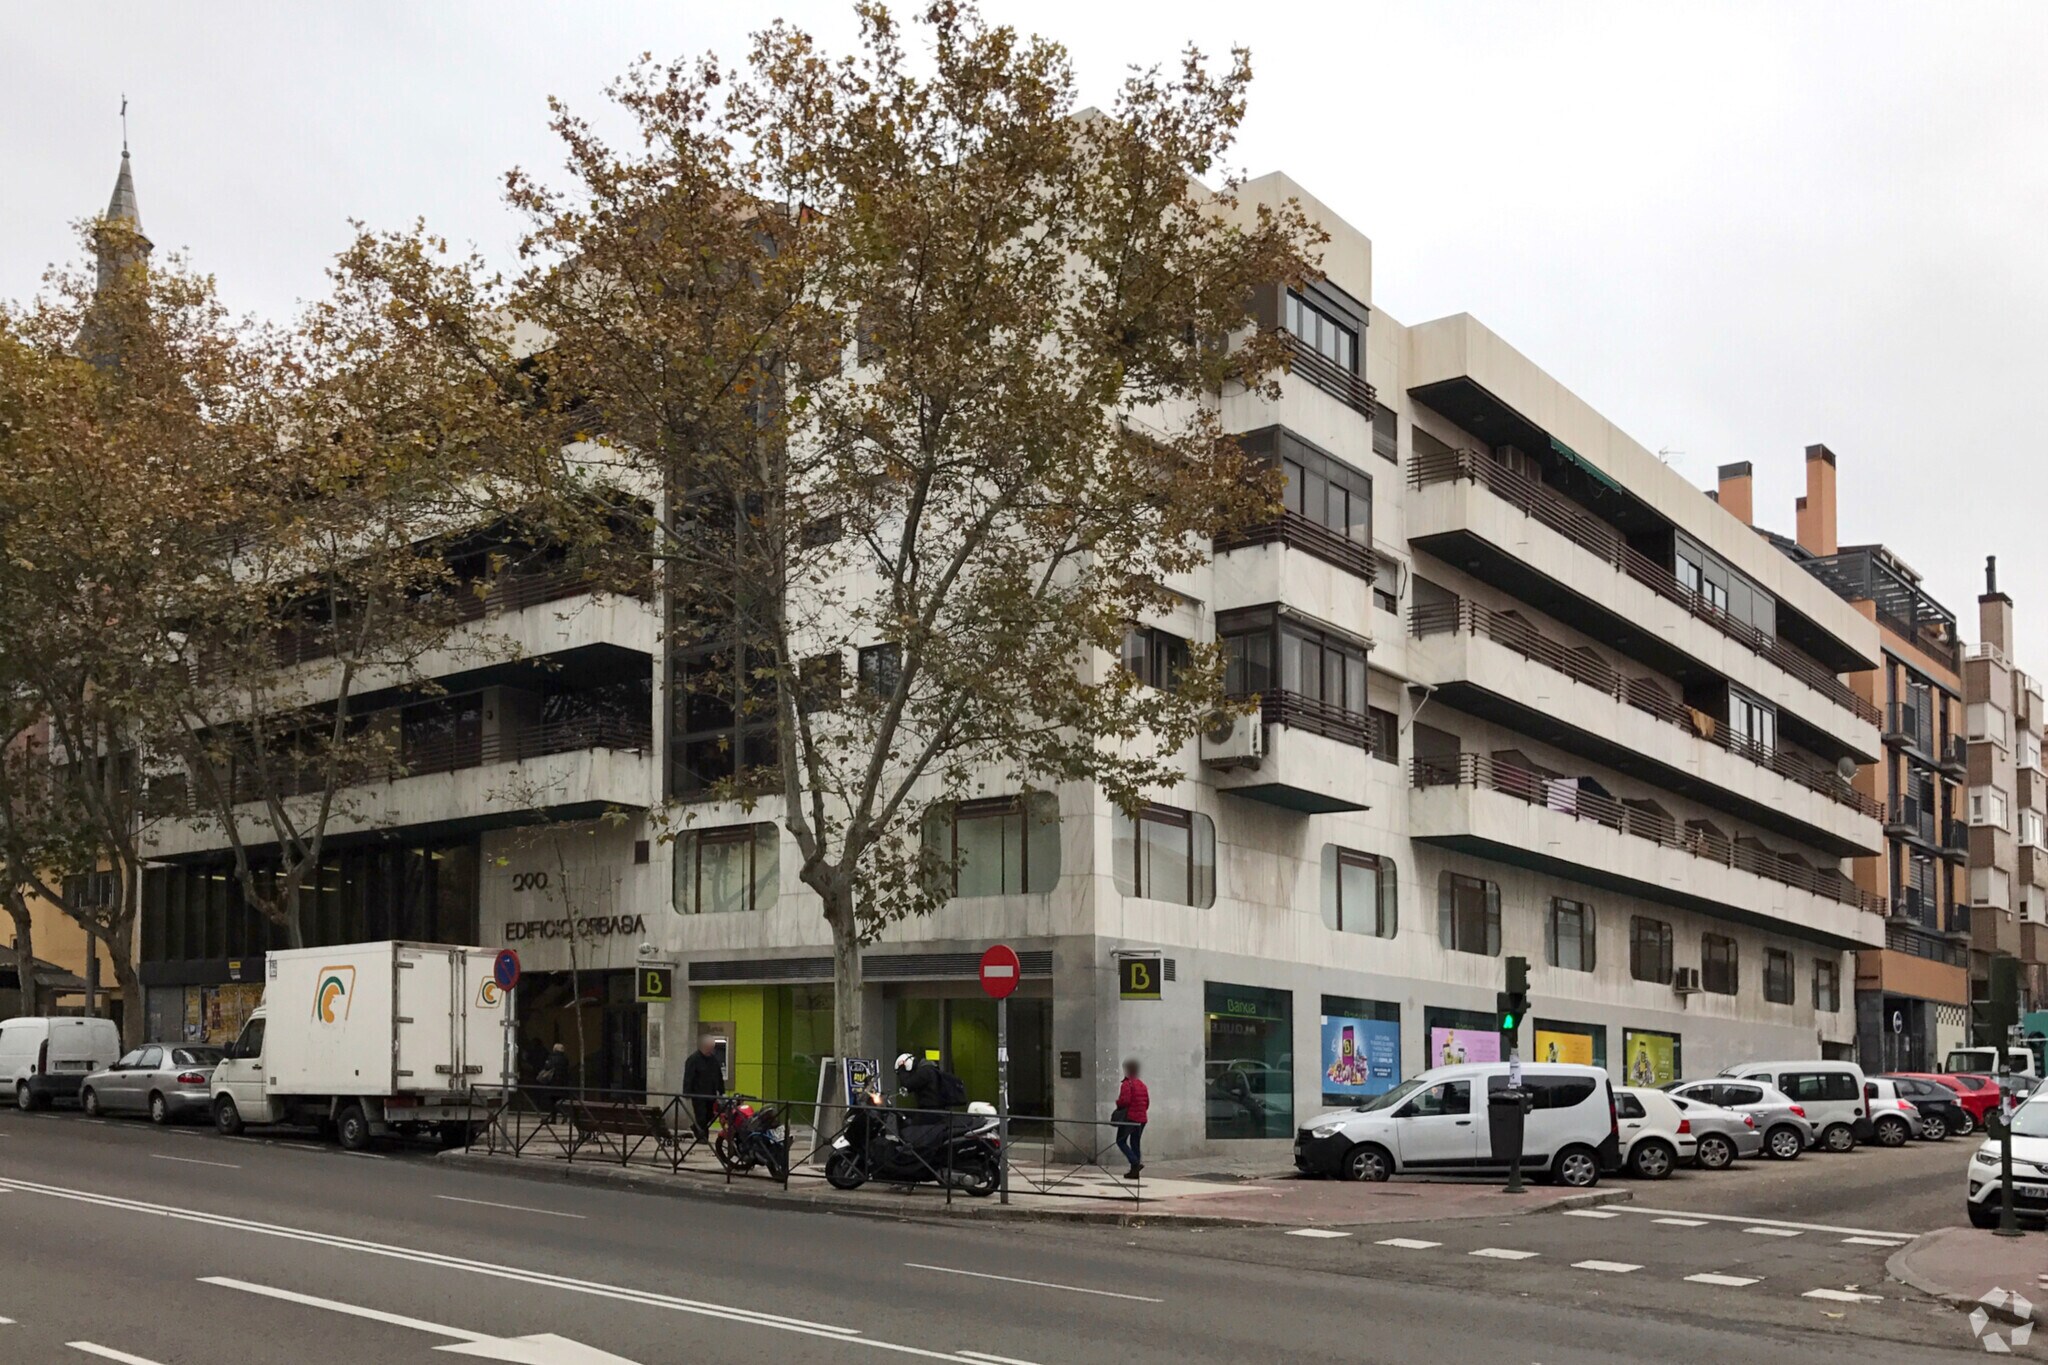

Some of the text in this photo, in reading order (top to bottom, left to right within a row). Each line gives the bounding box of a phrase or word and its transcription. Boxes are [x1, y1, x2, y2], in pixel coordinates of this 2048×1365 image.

[506, 919, 573, 941] EDIFICIO
[647, 971, 662, 994] B
[1131, 962, 1150, 989] B
[1227, 998, 1256, 1014] Bankia
